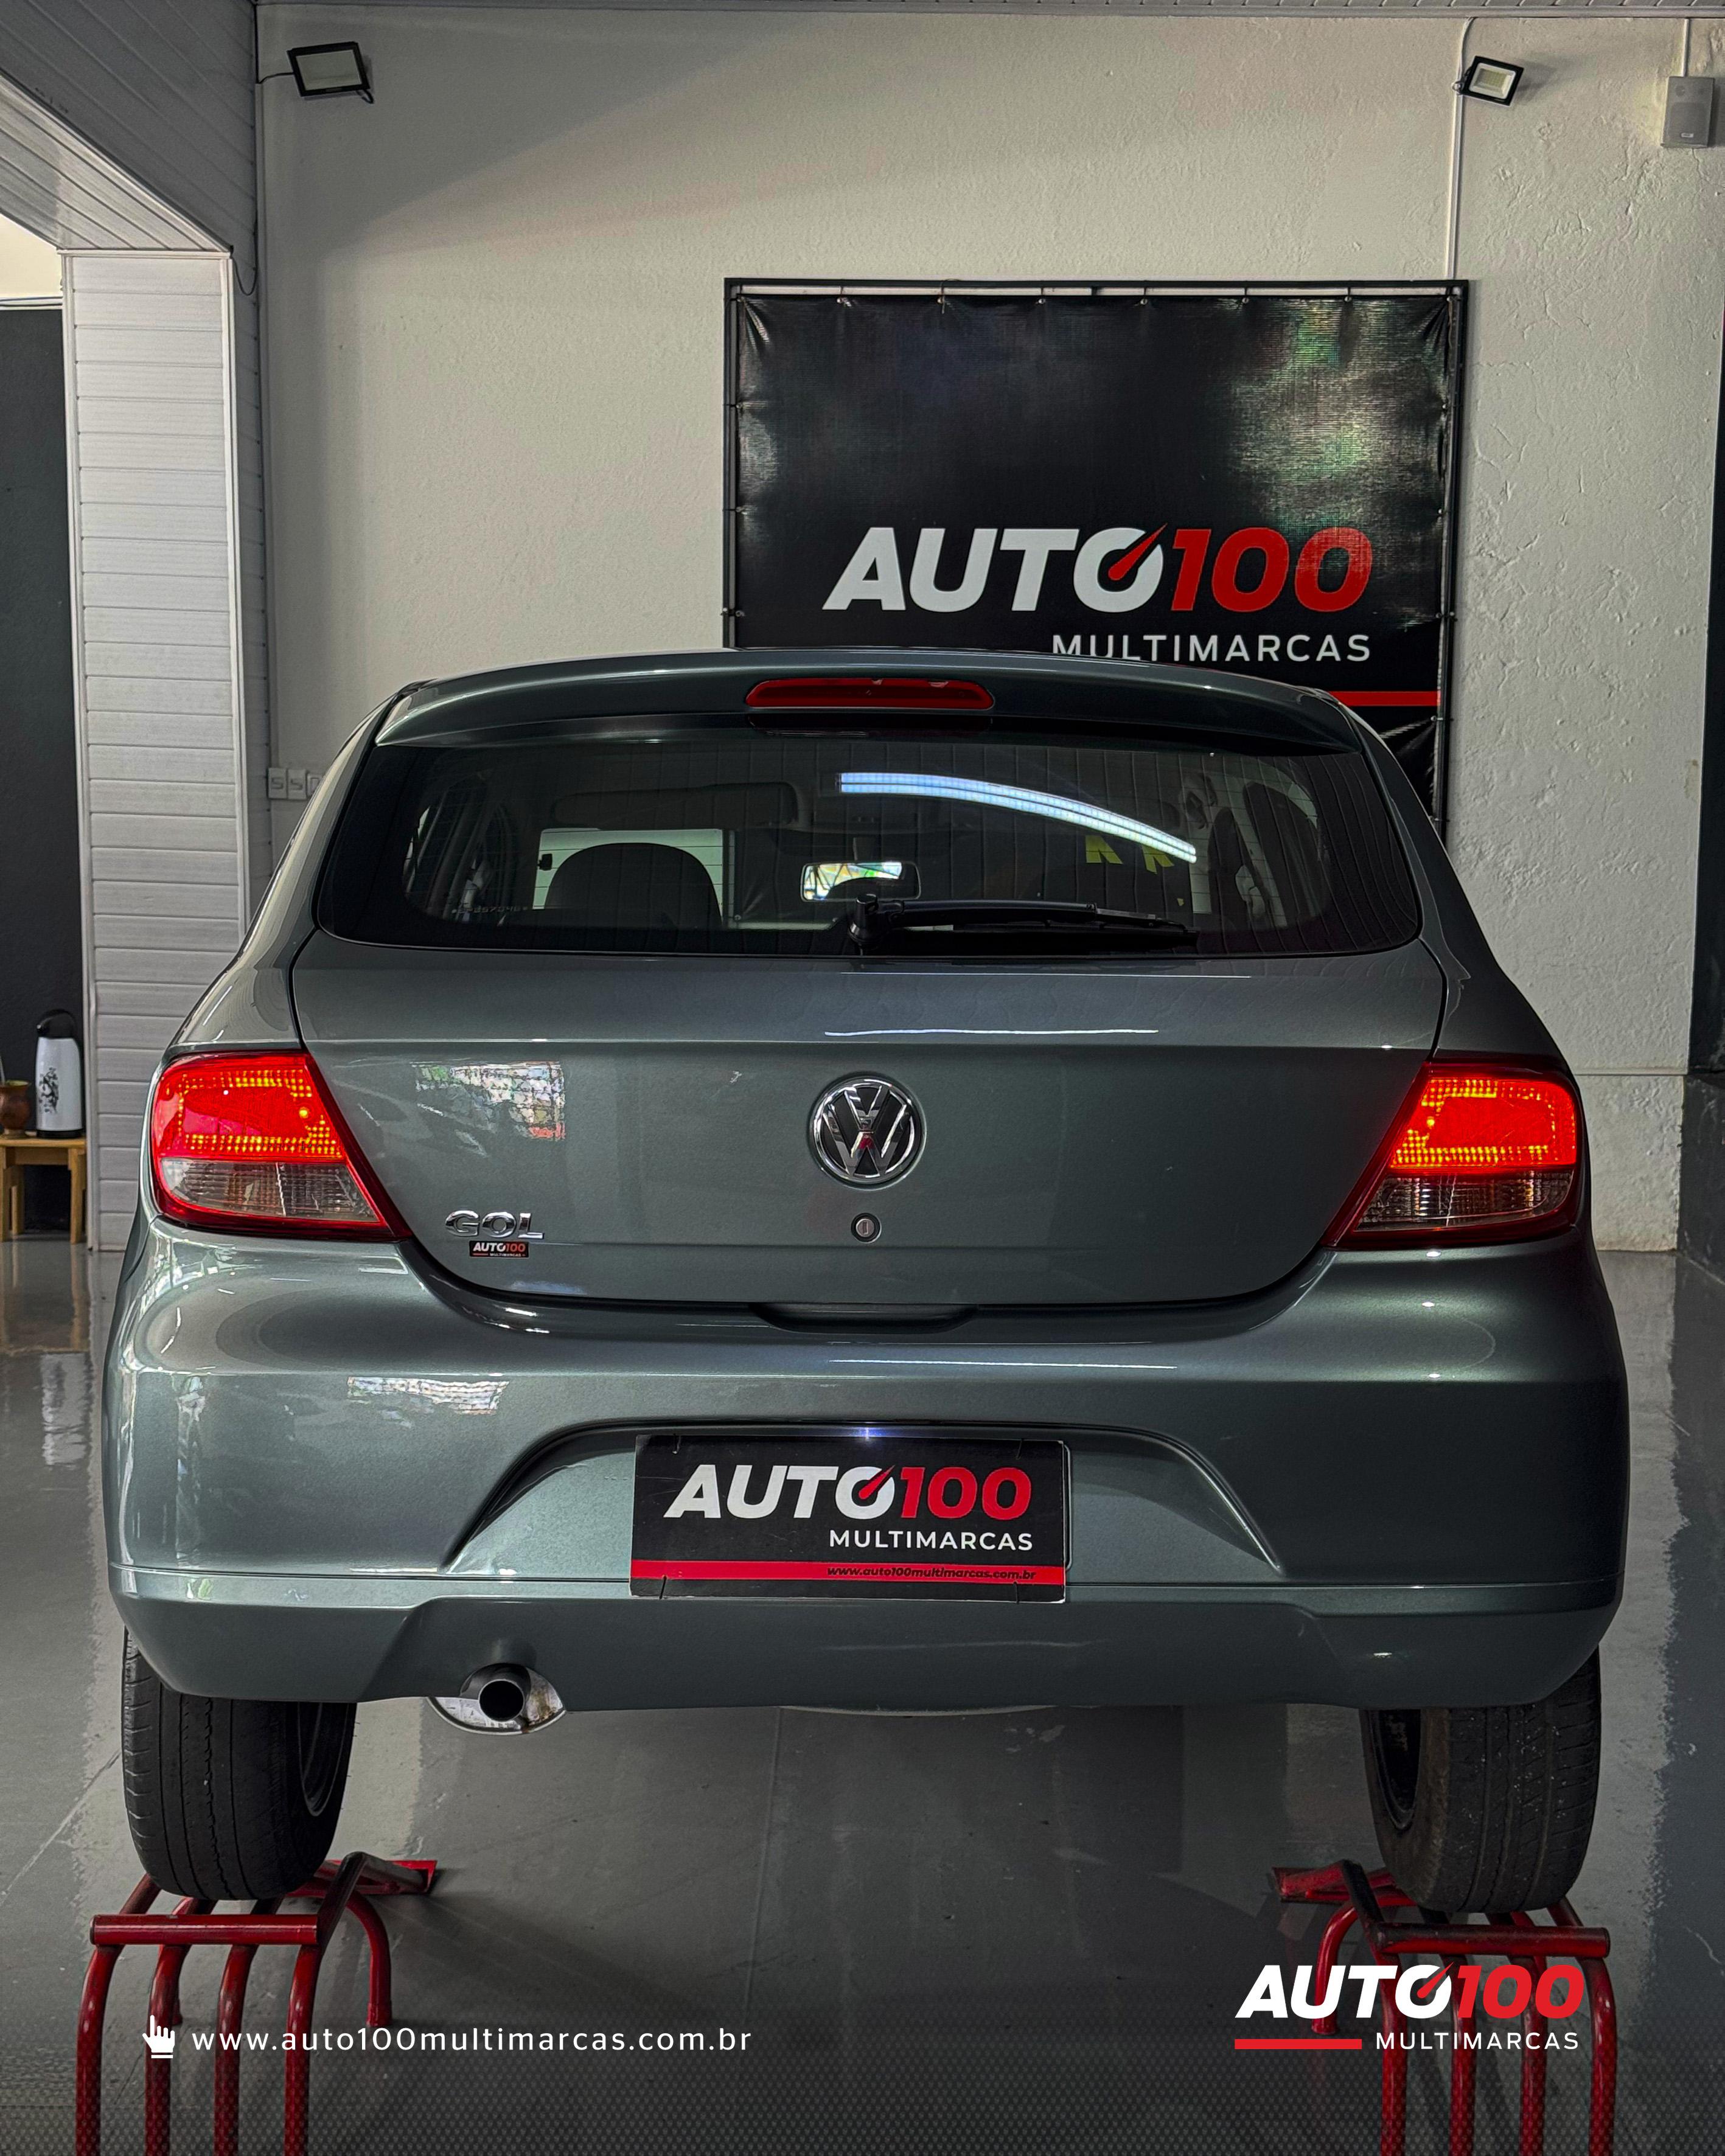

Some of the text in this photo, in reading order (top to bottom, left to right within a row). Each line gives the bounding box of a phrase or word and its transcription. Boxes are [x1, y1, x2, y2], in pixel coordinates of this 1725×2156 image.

[823, 524, 1373, 613] AUTO100
[1052, 634, 1370, 662] MULTIMARCAS
[445, 1210, 544, 1239] GOL
[472, 1242, 526, 1253] AUTO100
[663, 1464, 1032, 1520] AUTO100
[829, 1529, 1033, 1551] MULTIMARCAS
[827, 1567, 1037, 1580] www.auto100multimarcas.com.br
